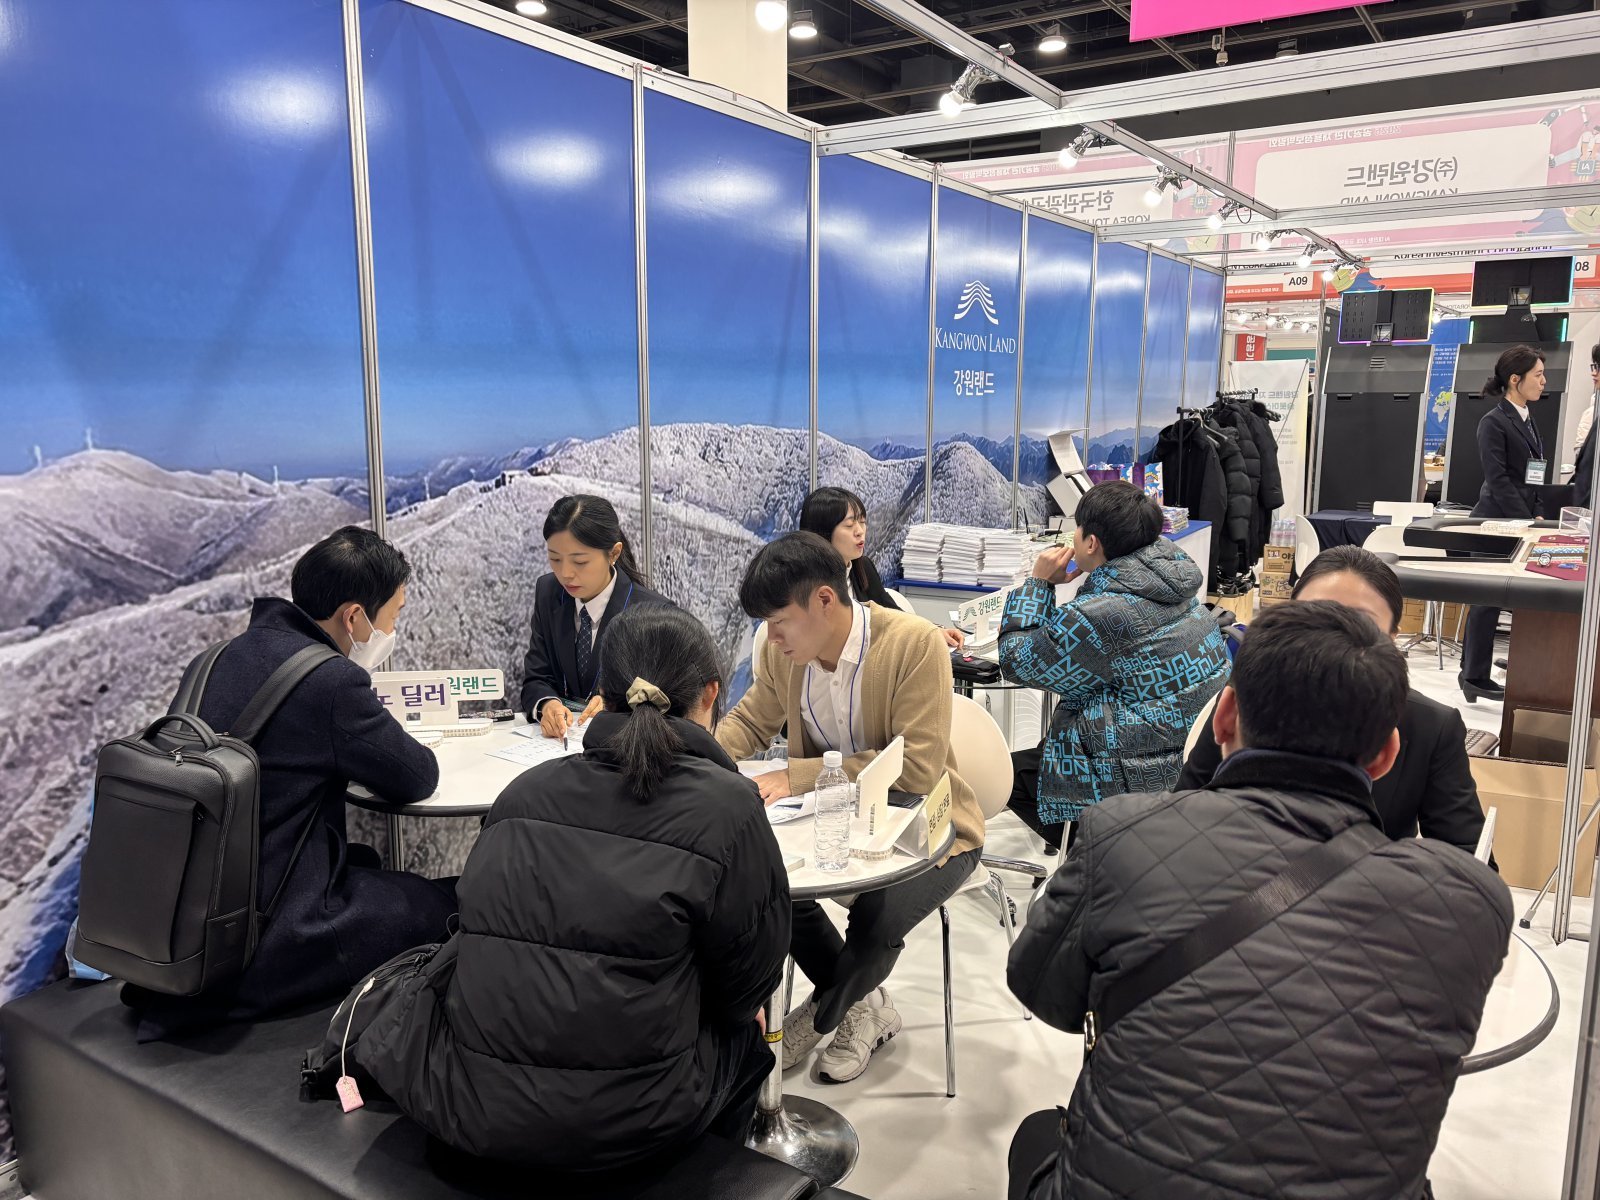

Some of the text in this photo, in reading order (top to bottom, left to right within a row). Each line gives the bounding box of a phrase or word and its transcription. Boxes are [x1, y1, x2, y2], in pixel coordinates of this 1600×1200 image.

[1575, 261, 1590, 272] 08
[1288, 276, 1308, 286] A09
[935, 326, 1017, 354] KANGWON LAND
[953, 370, 995, 396] 강원랜드
[401, 683, 445, 707] 딜러
[445, 676, 499, 695] 원랜드
